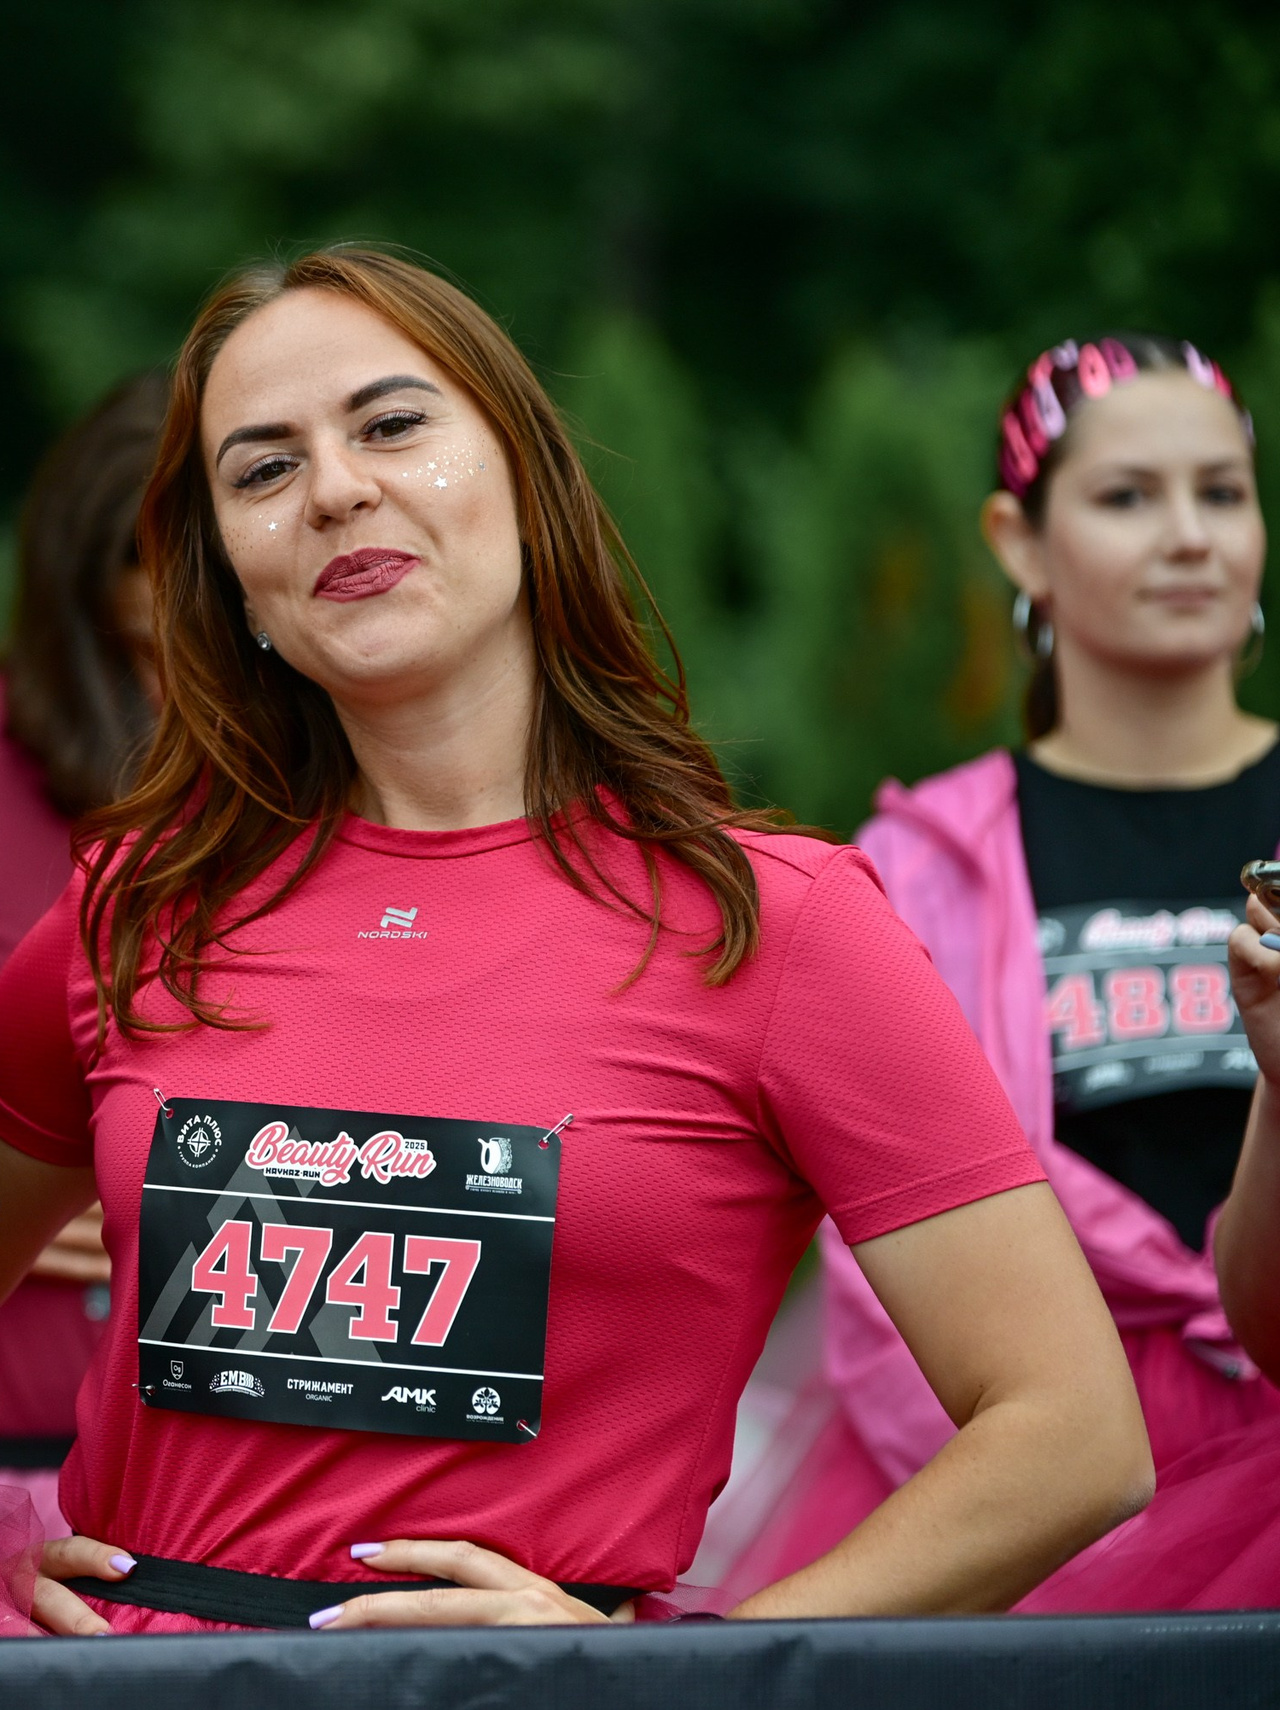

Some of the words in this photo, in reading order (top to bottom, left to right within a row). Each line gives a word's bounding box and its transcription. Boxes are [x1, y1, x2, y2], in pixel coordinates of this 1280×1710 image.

[357, 931, 428, 939] NORDSKI
[1045, 964, 1240, 1049] 488
[177, 1114, 201, 1143] ВИТА
[203, 1114, 222, 1147] ПЛЮС
[404, 1141, 425, 1150] 2025
[247, 1124, 357, 1184] Beauty
[360, 1134, 433, 1181] Run
[465, 1174, 523, 1189] ЖЕЛЕЗНОВОДСК
[191, 1219, 482, 1348] 4747
[287, 1378, 354, 1395] СТРИЖАМЕНТ
[305, 1393, 333, 1402] ORGANIC
[415, 1405, 436, 1413] clinic
